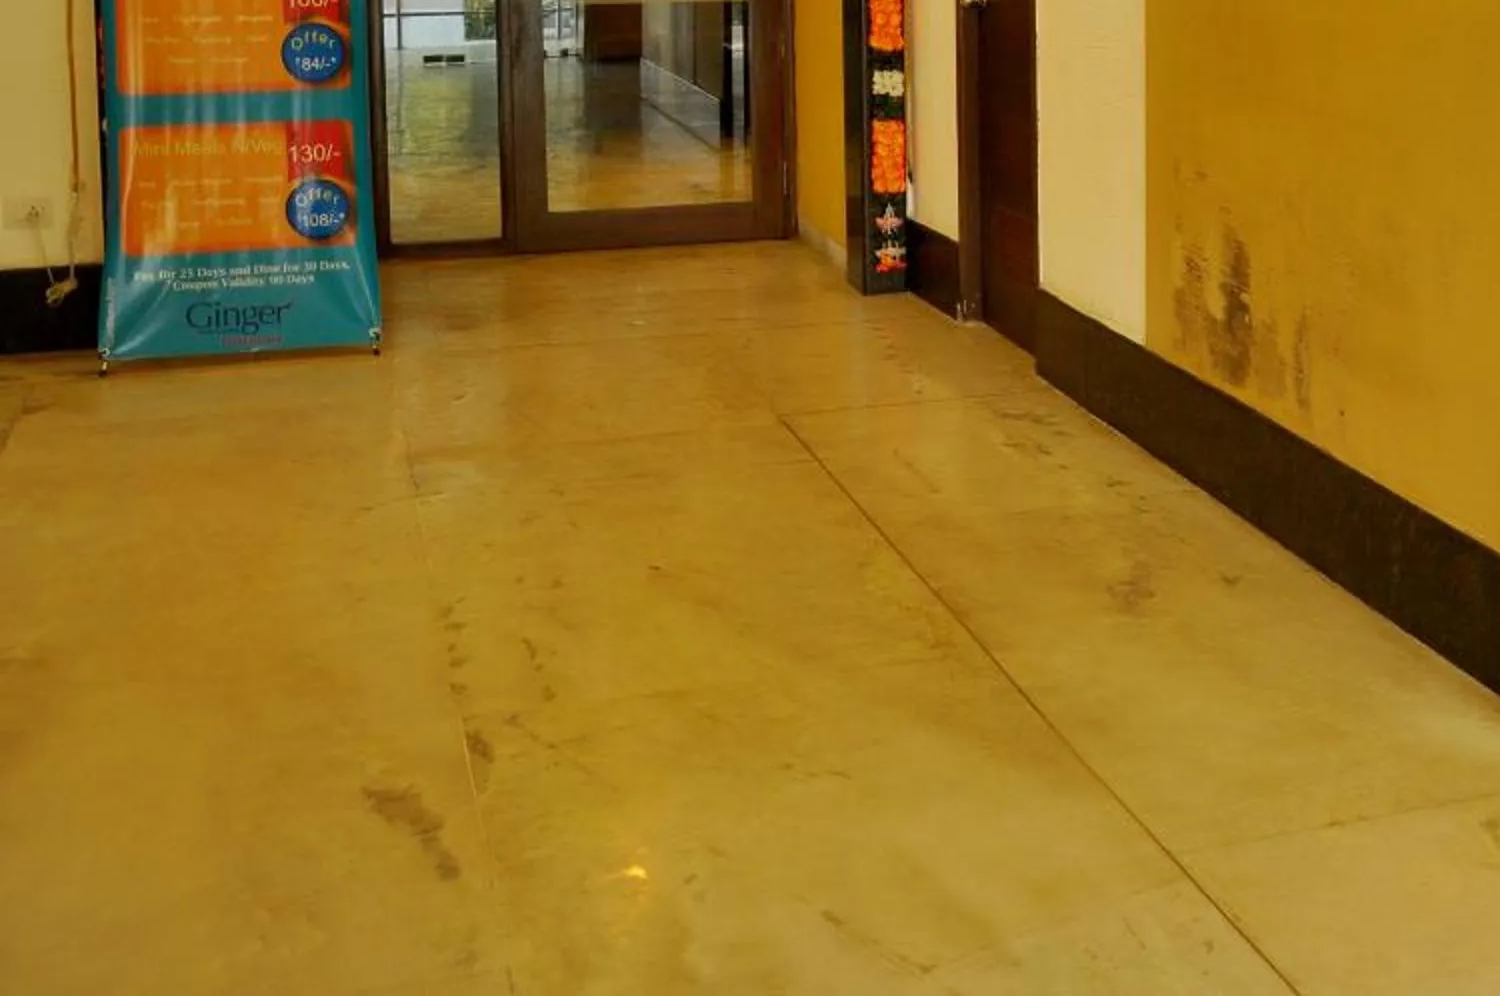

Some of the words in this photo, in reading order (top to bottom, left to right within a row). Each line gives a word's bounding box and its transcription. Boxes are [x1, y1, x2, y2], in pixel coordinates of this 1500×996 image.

[290, 29, 336, 52] Offer
[289, 143, 341, 163] 130/-
[295, 187, 340, 207] Offer
[197, 267, 226, 280] Days
[185, 300, 291, 335] Ginger
